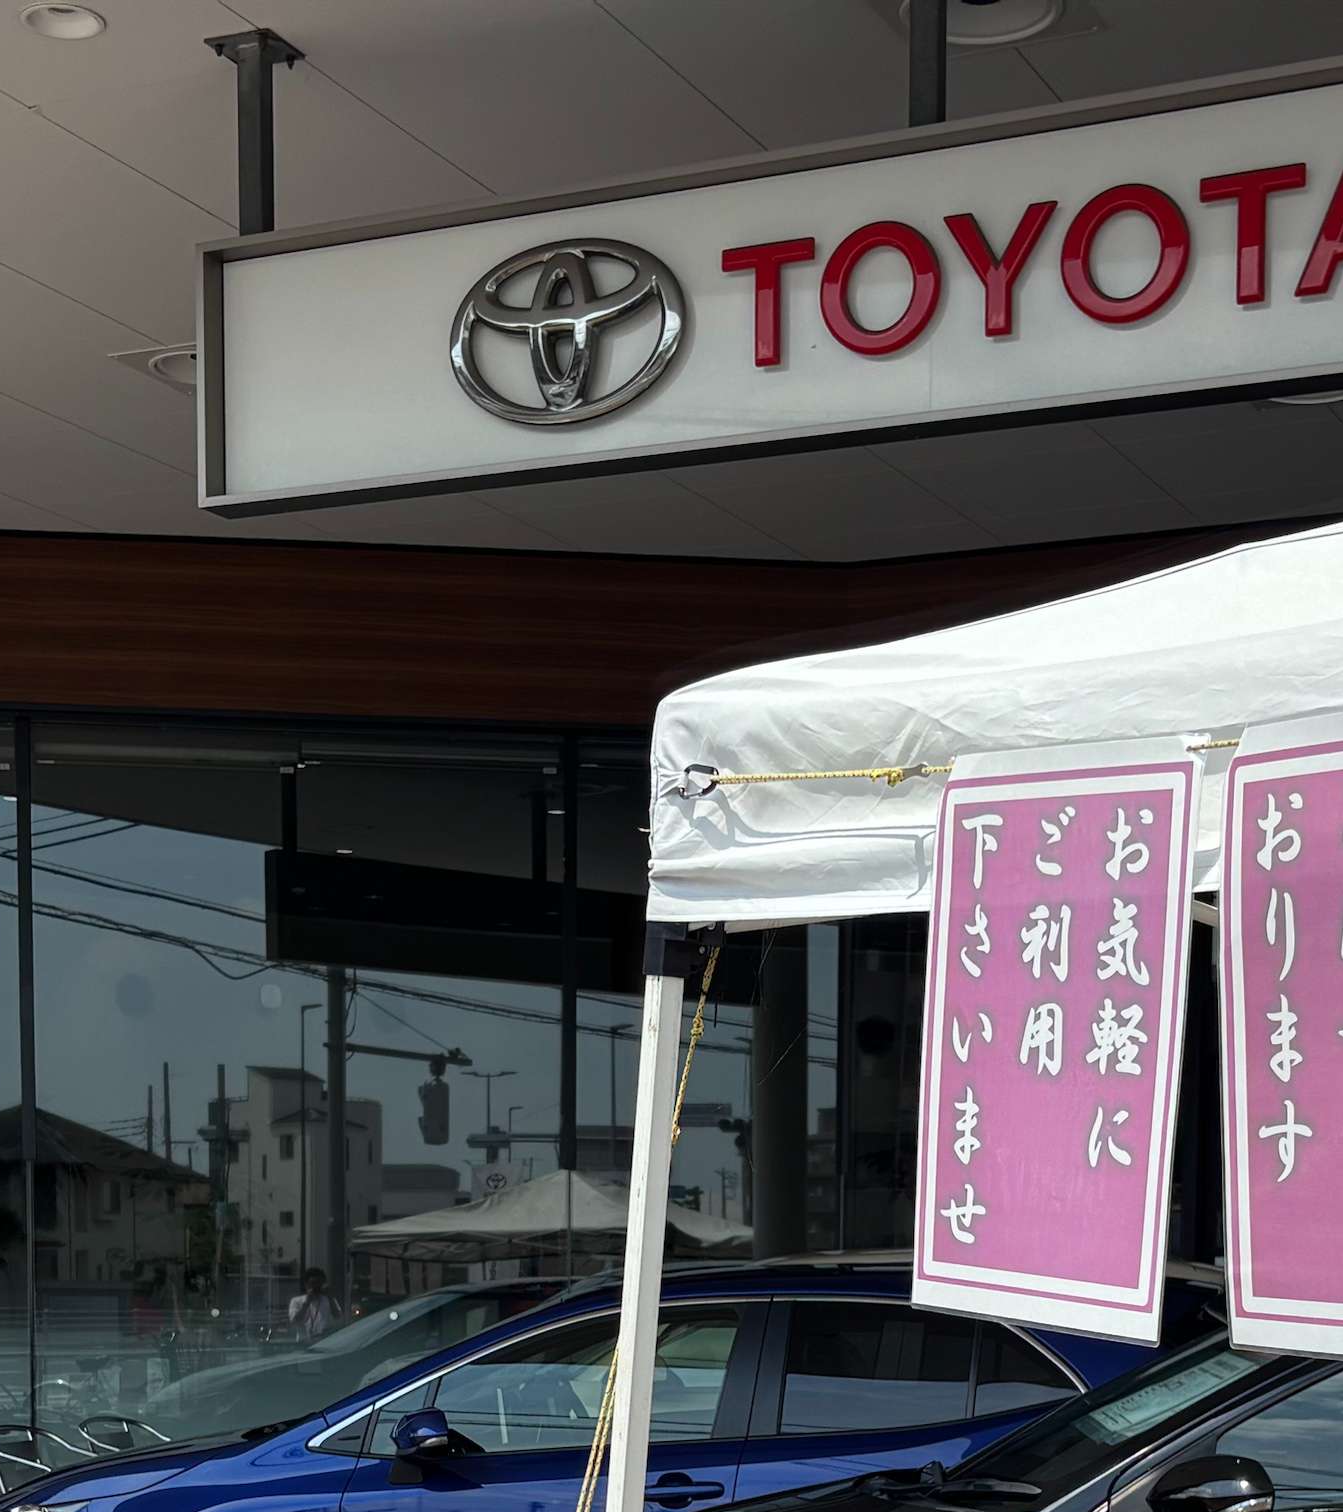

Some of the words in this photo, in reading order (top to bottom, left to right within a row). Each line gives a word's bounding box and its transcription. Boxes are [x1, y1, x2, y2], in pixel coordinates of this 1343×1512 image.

[940, 813, 1003, 1244] 下さいませ
[1019, 806, 1076, 1077] ご利用
[1086, 807, 1153, 1168] お気軽に
[1256, 792, 1314, 1183] おります
